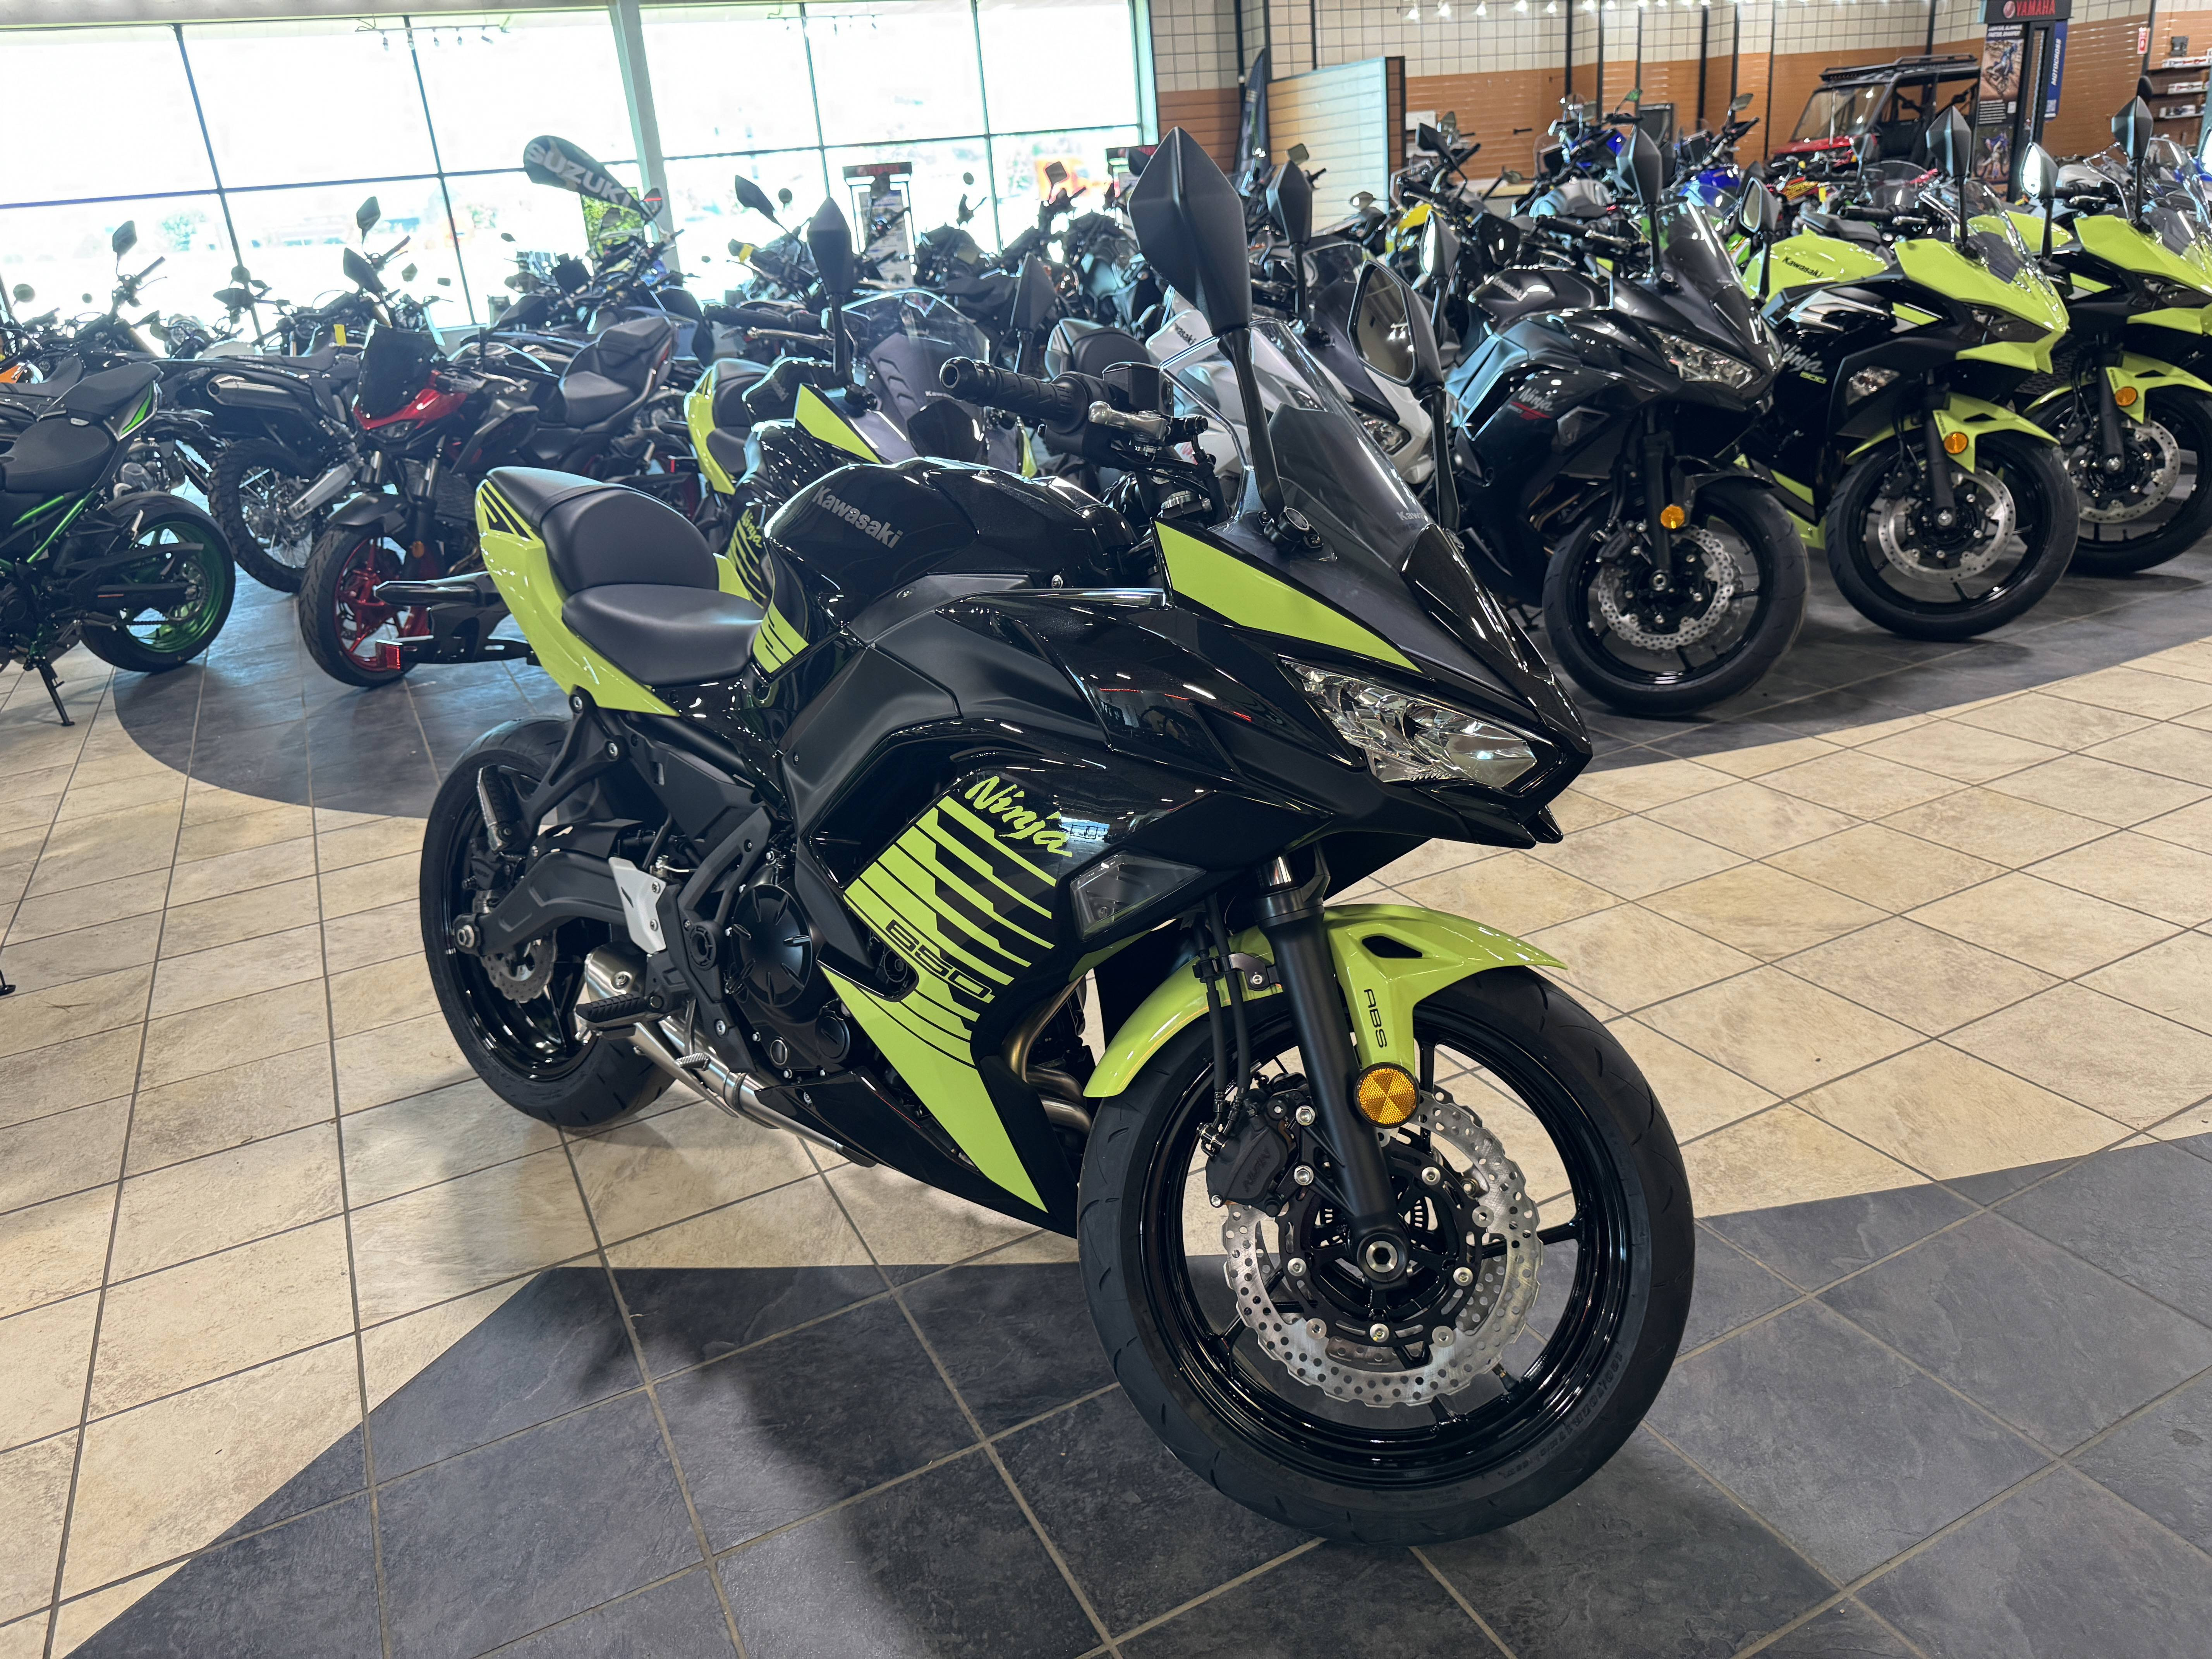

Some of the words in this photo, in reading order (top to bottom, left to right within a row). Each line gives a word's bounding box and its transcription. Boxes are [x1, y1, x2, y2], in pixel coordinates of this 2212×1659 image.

[2016, 0, 2056, 17] YAMAHA
[2051, 38, 2062, 86] MOTOCROSS
[525, 143, 632, 207] SUZUKI
[1782, 256, 1824, 278] Kawasaki
[1518, 387, 1553, 411] Ninja
[741, 508, 763, 549] Ninja
[812, 485, 903, 549] Kawasaki
[964, 775, 1073, 857] Ninja
[885, 919, 992, 999] 650
[1364, 988, 1388, 1048] ABS
